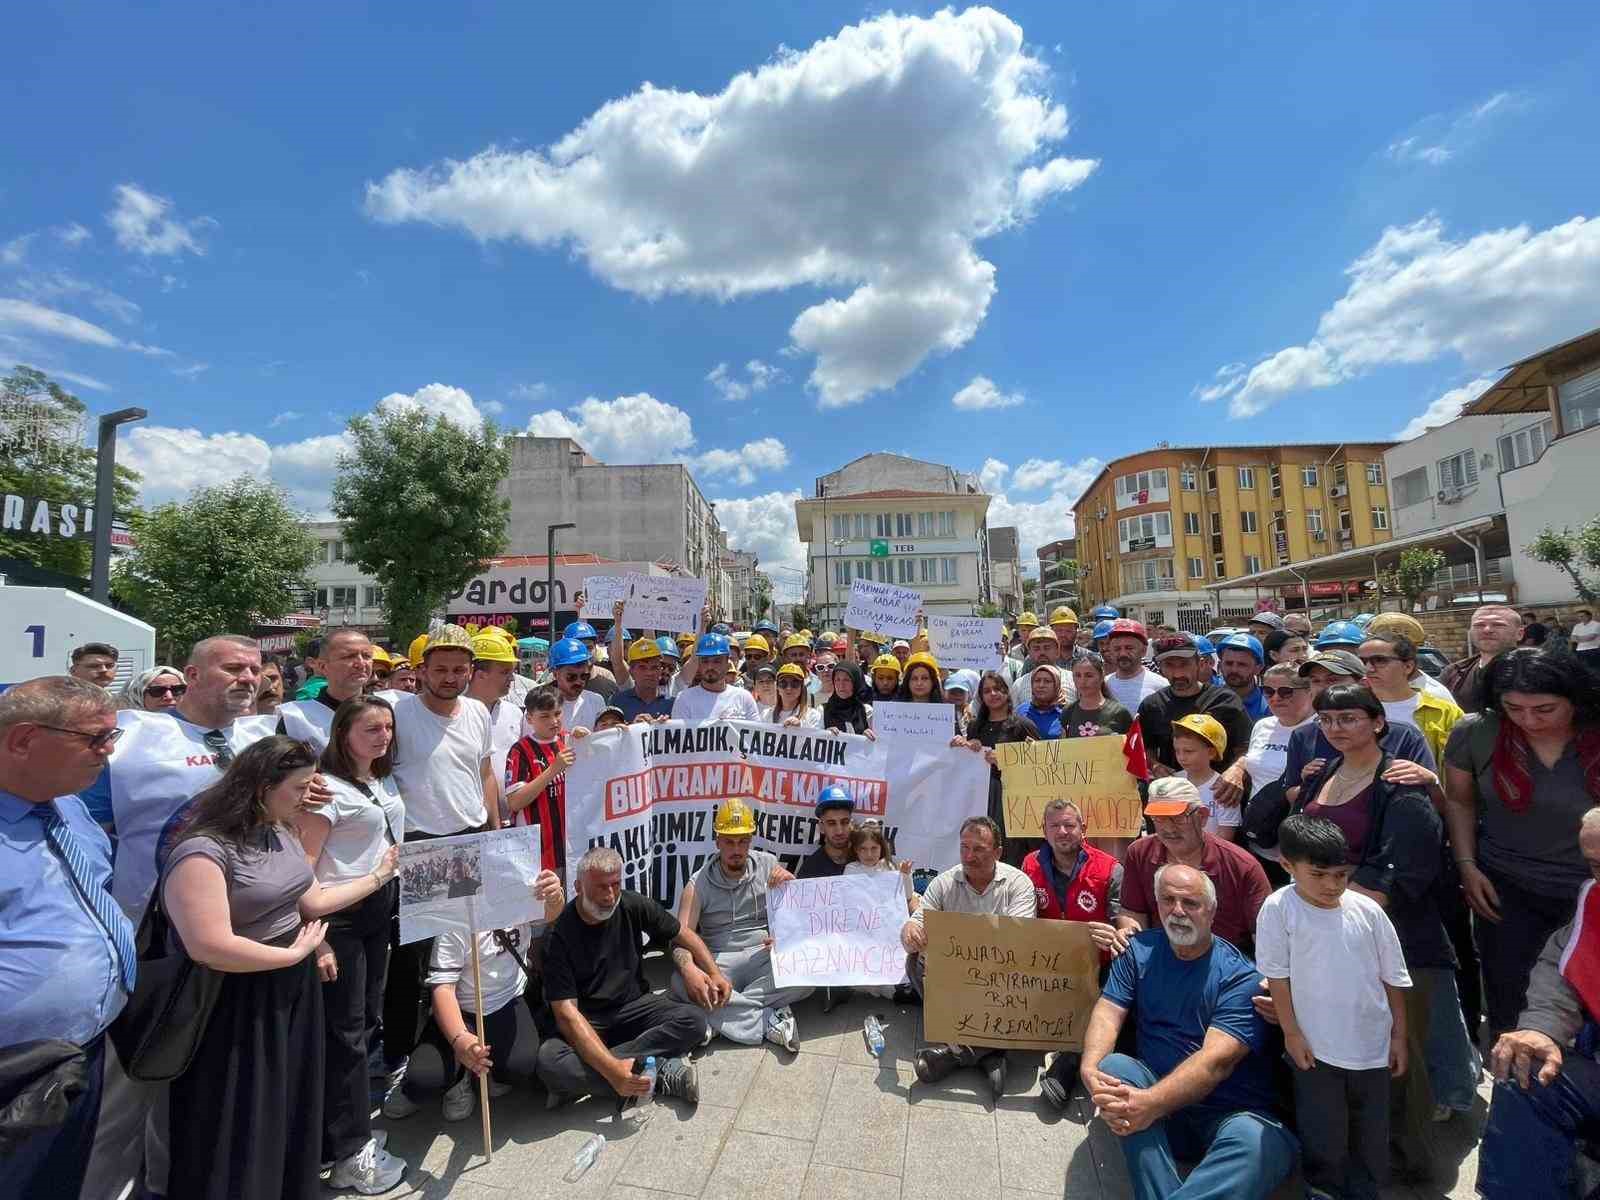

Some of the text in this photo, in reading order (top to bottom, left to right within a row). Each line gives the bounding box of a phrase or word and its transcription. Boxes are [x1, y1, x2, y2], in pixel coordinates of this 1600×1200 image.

[893, 543, 915, 553] TEB
[24, 625, 45, 658] 1
[738, 728, 848, 766] ÇABALADIK
[726, 764, 754, 795] DA
[758, 768, 787, 804] AÇ
